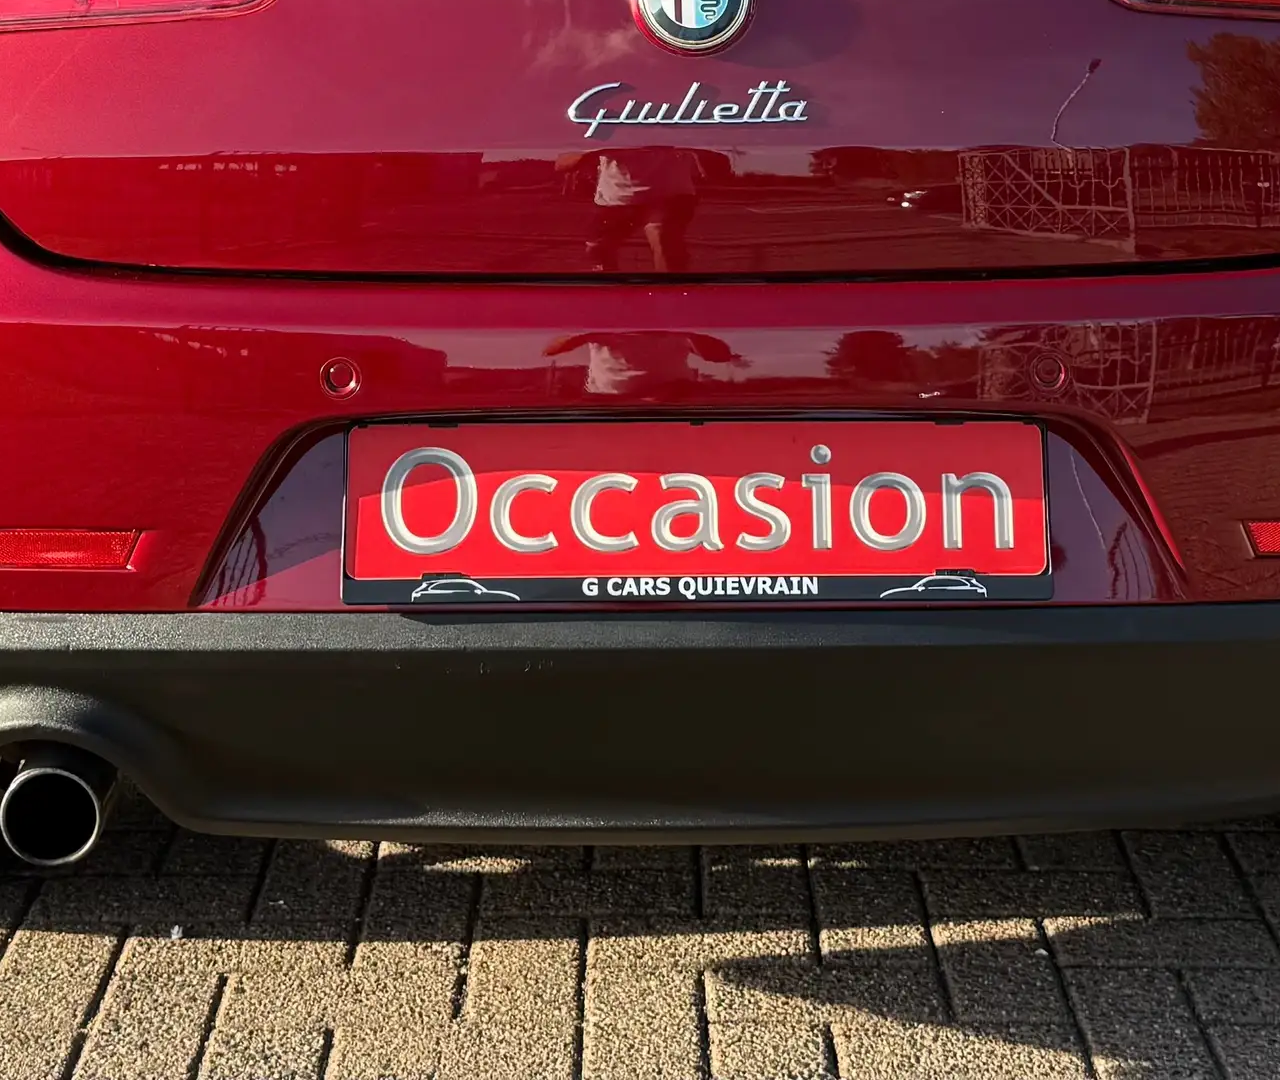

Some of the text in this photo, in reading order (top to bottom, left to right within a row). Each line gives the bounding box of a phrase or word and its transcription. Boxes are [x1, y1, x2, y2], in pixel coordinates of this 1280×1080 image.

[567, 80, 808, 138] Giulietta
[380, 444, 1016, 555] Occasion
[582, 576, 819, 600] G CARS QUIEVRAIN
